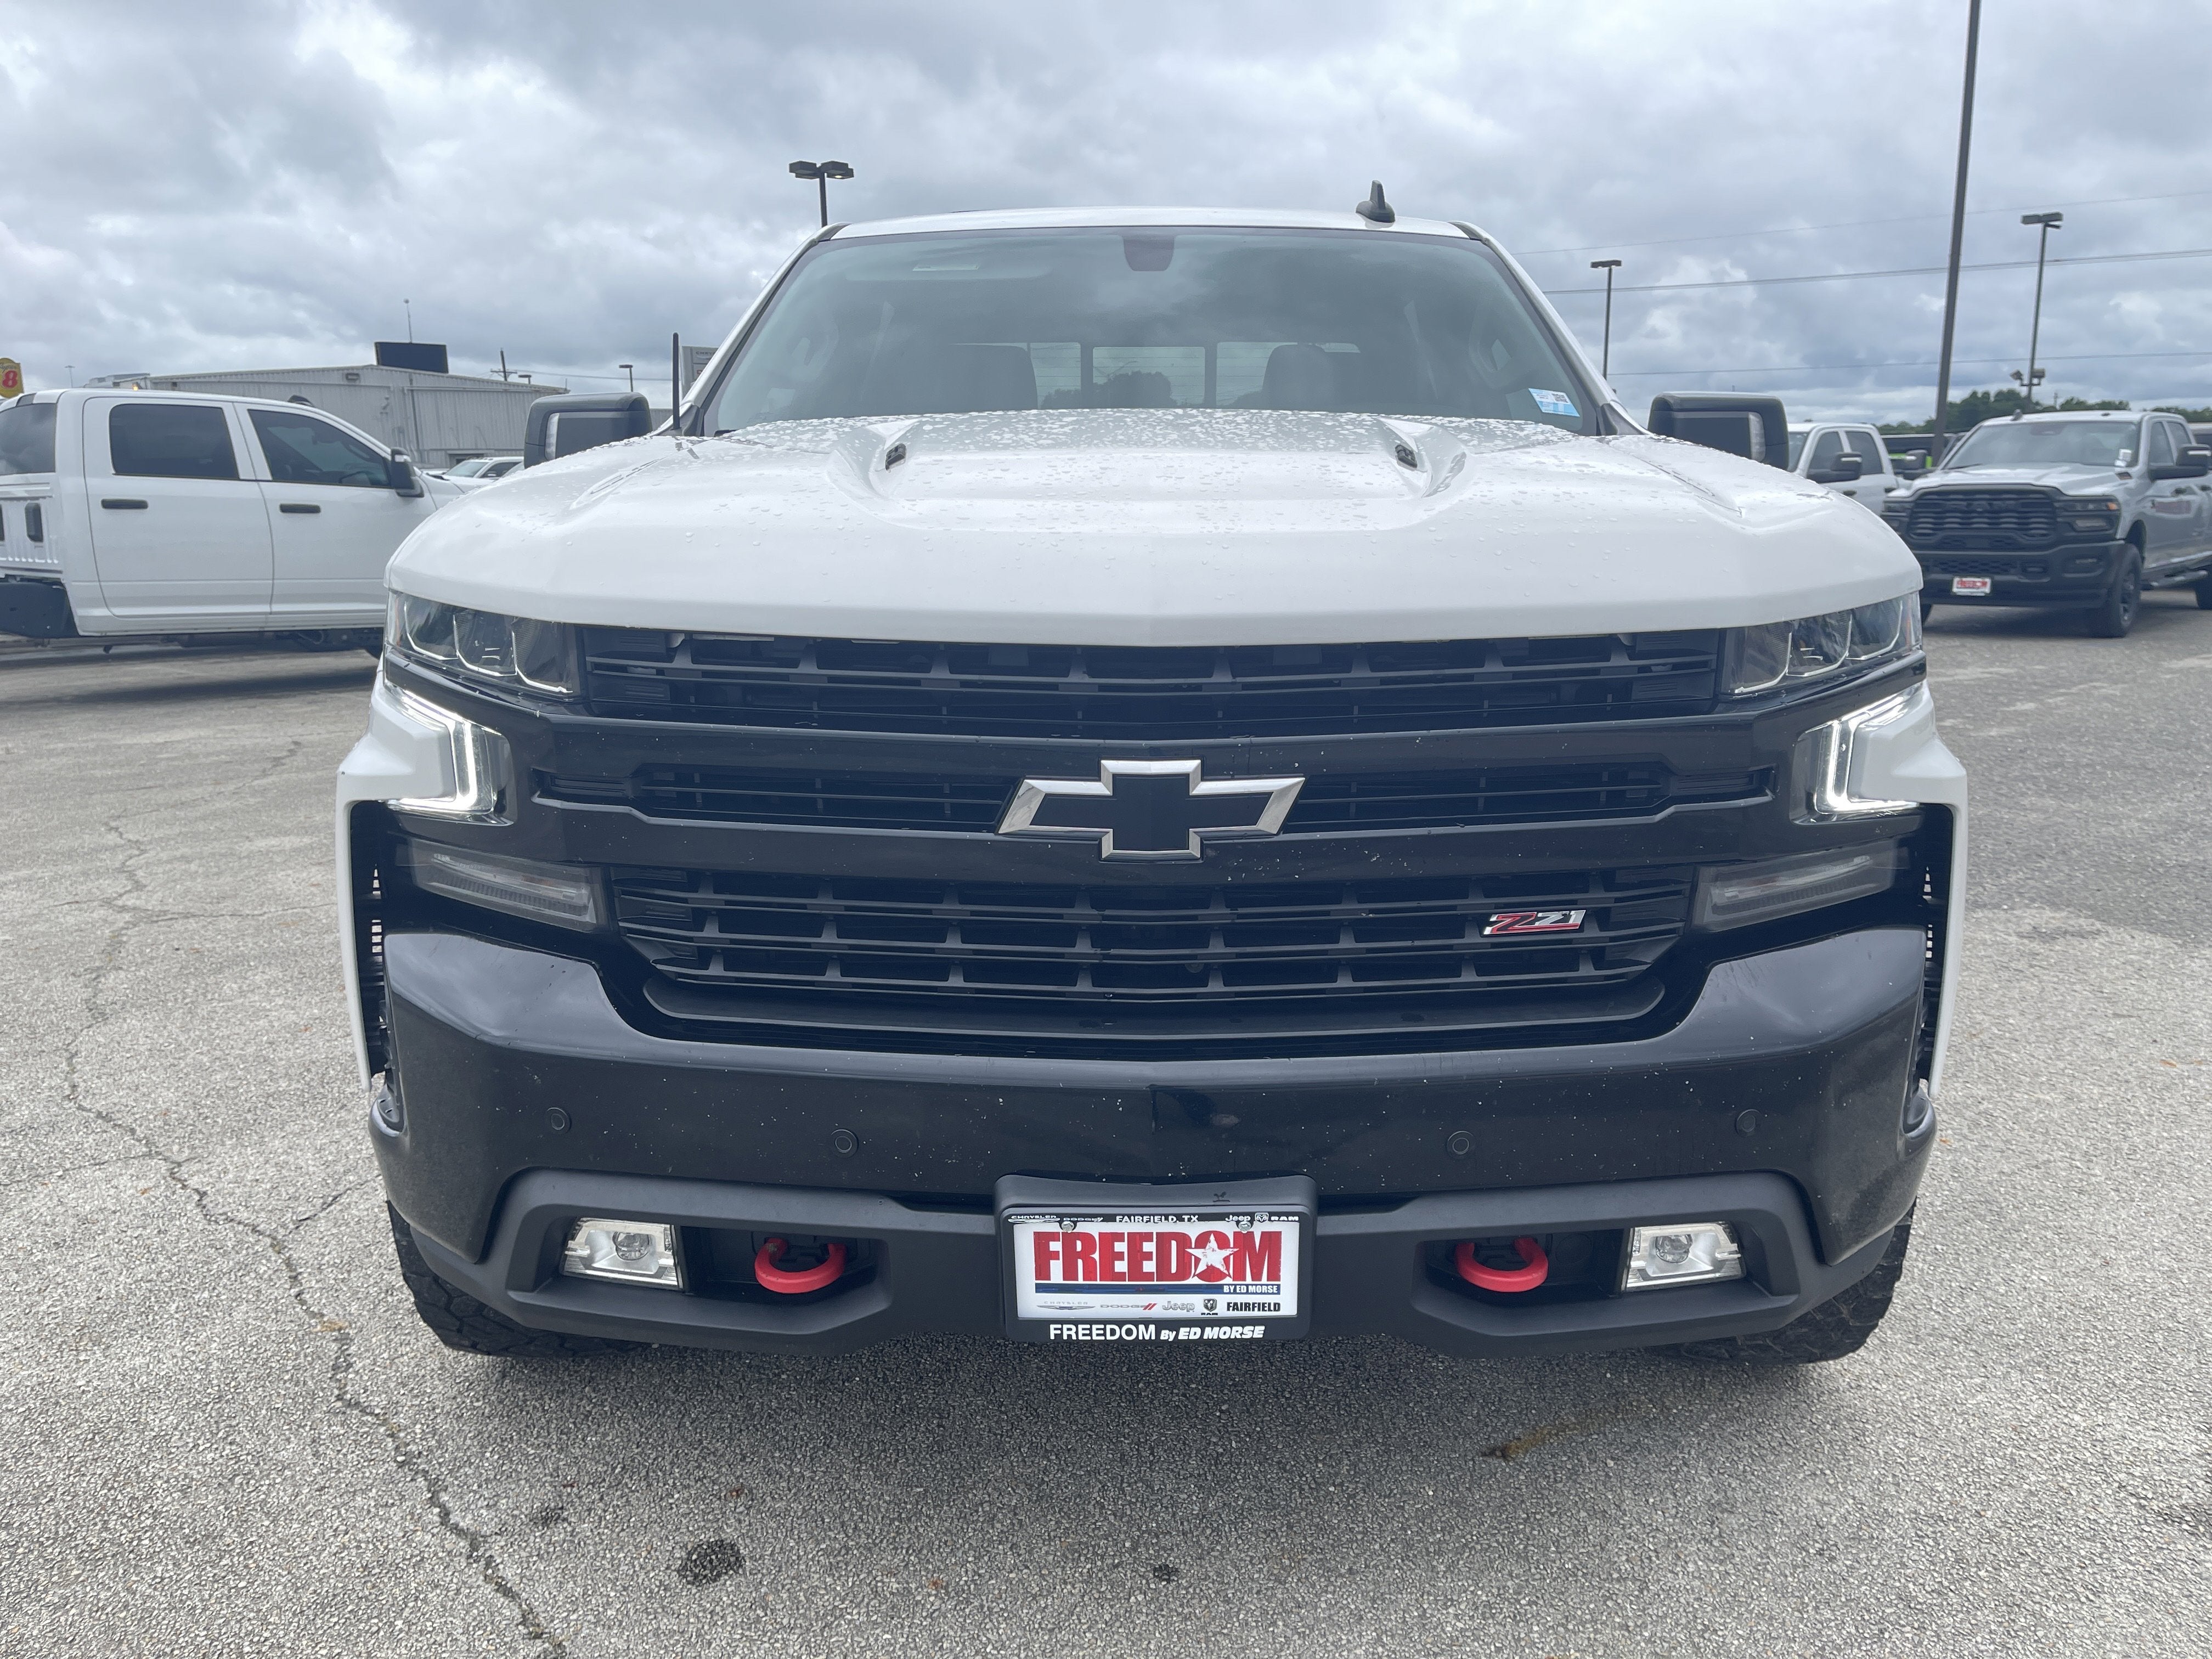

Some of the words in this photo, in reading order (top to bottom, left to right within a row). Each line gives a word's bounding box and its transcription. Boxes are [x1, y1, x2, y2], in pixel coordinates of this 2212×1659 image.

[2, 370, 18, 389] 8
[1483, 910, 1586, 935] Z71
[1034, 1231, 1282, 1282] FREEDOM
[1223, 1285, 1235, 1293] BY
[1236, 1285, 1247, 1293] ED
[1248, 1285, 1278, 1293] MORSE
[1162, 1301, 1195, 1312] Jeep
[1226, 1302, 1281, 1312] FAIRFIELD
[1049, 1324, 1155, 1340] FREEDOM
[1160, 1329, 1176, 1341] By
[1178, 1327, 1201, 1340] ED
[1203, 1325, 1265, 1339] MORSE
